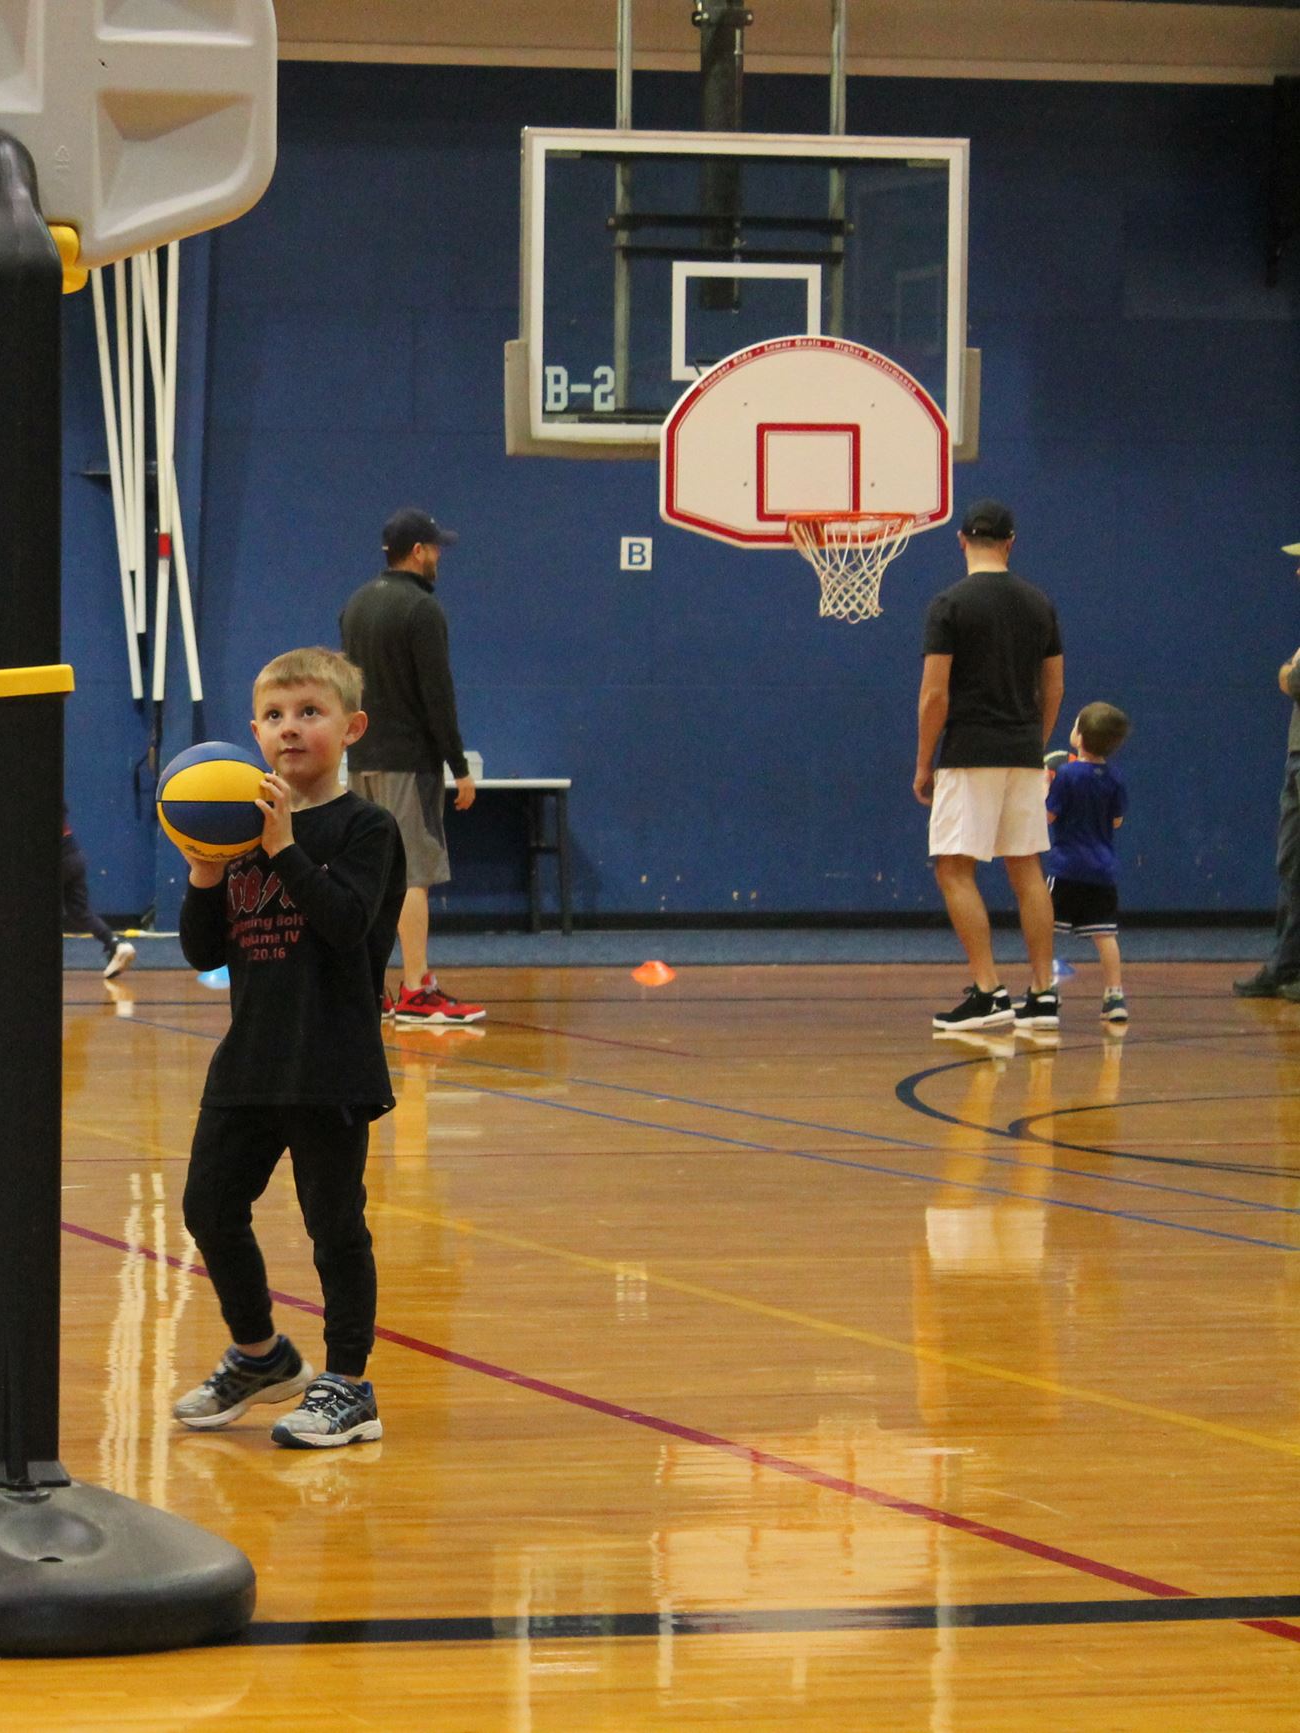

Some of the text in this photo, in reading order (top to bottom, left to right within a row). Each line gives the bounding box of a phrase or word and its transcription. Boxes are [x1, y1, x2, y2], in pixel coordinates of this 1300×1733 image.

[764, 341, 792, 353] Lower
[834, 341, 864, 357] Higher
[544, 365, 615, 411] B-2
[628, 542, 646, 566] B
[284, 930, 300, 944] IV
